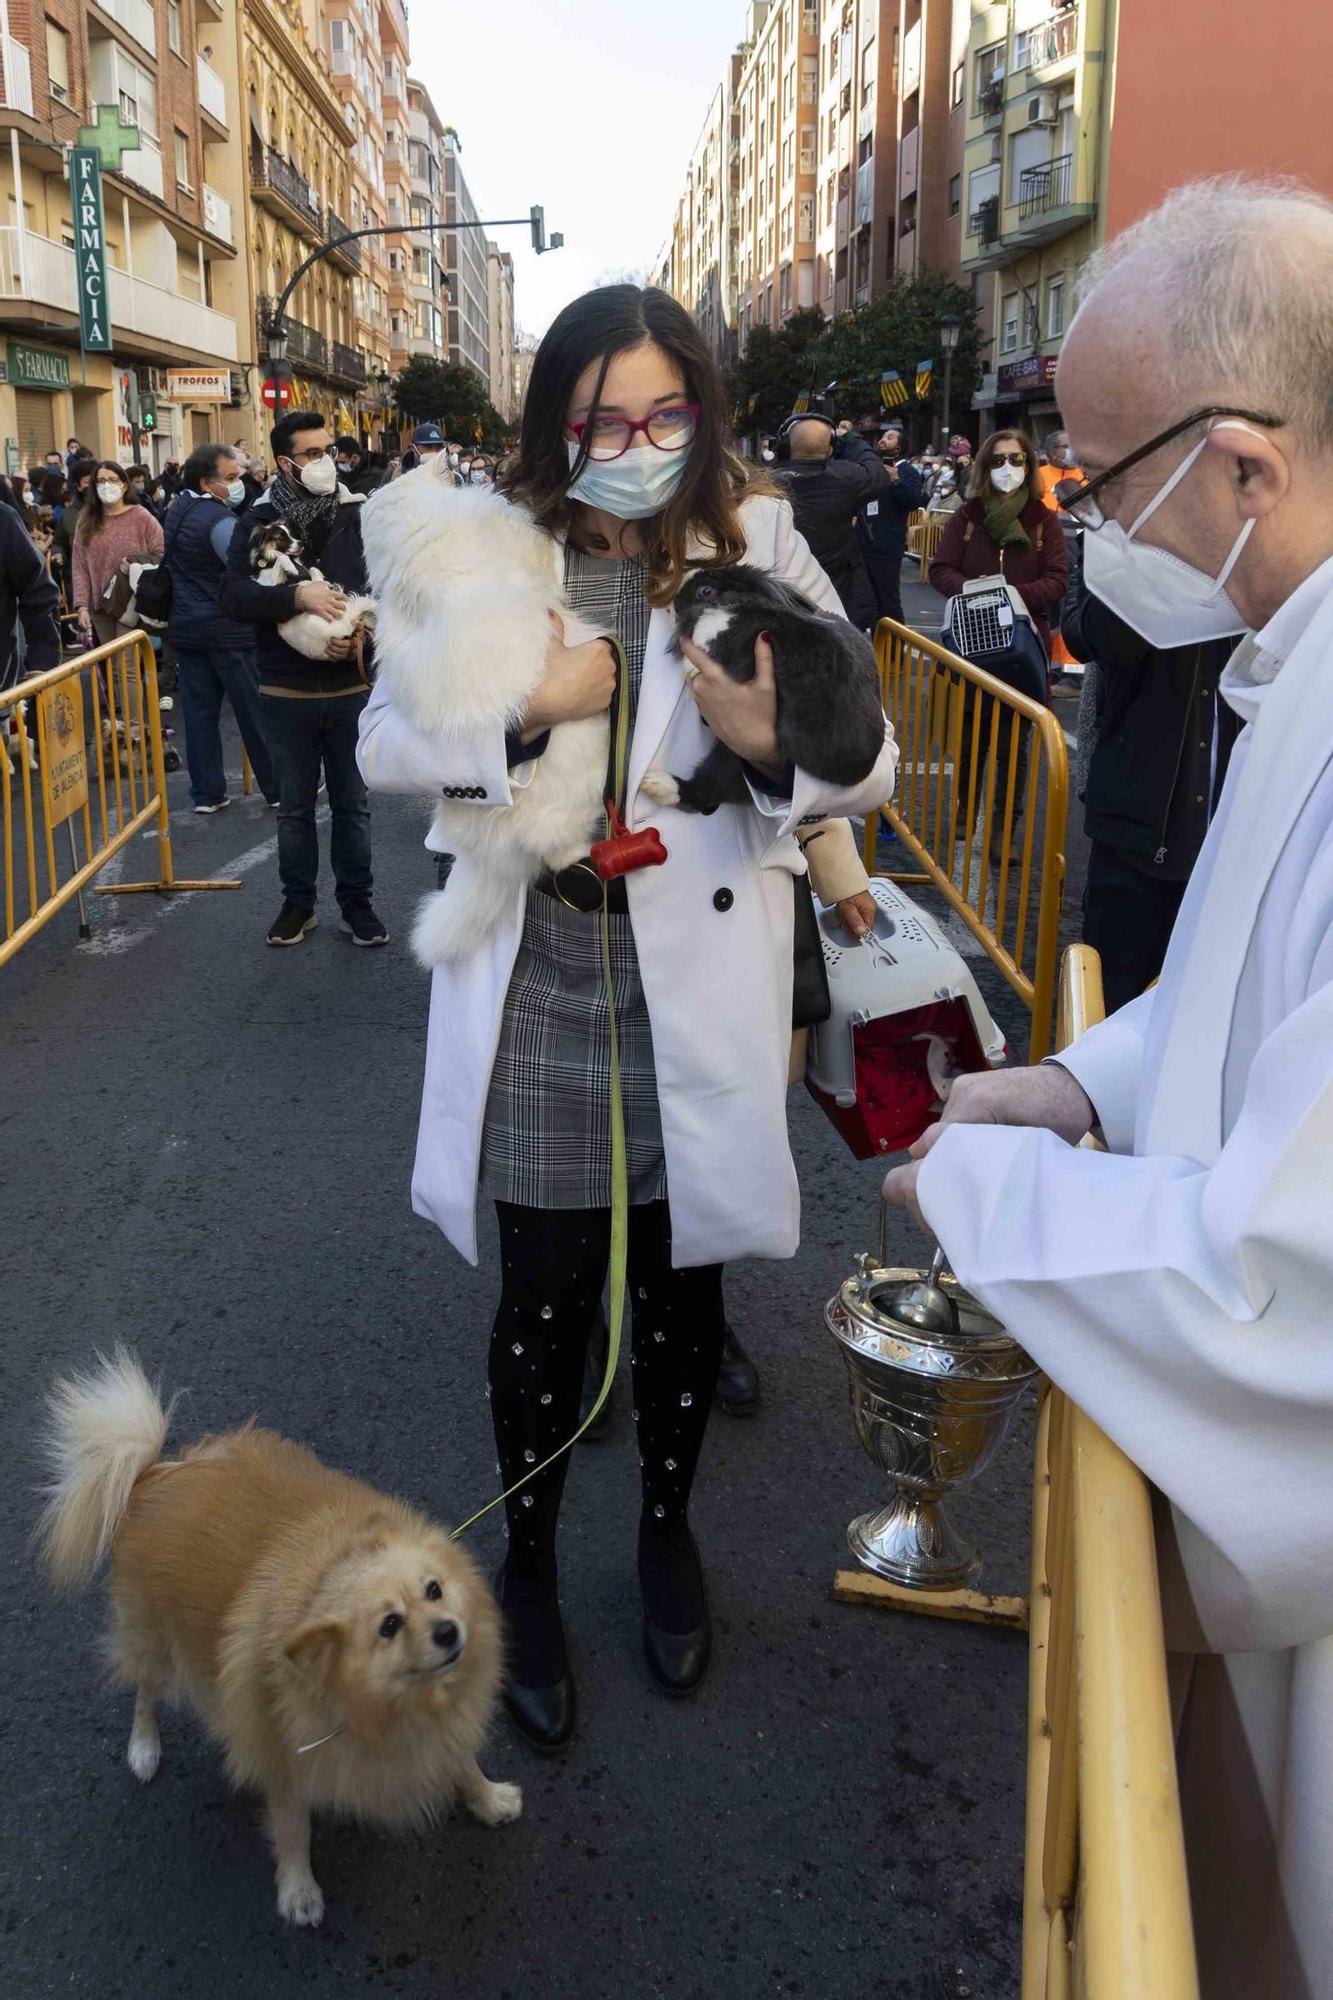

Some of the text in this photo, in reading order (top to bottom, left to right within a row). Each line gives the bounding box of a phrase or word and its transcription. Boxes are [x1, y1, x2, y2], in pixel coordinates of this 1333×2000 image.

[80, 157, 104, 342] FARMACIA
[26, 351, 69, 384] FARMACIA
[178, 377, 220, 385] TROFEOS
[118, 425, 149, 447] TROOS
